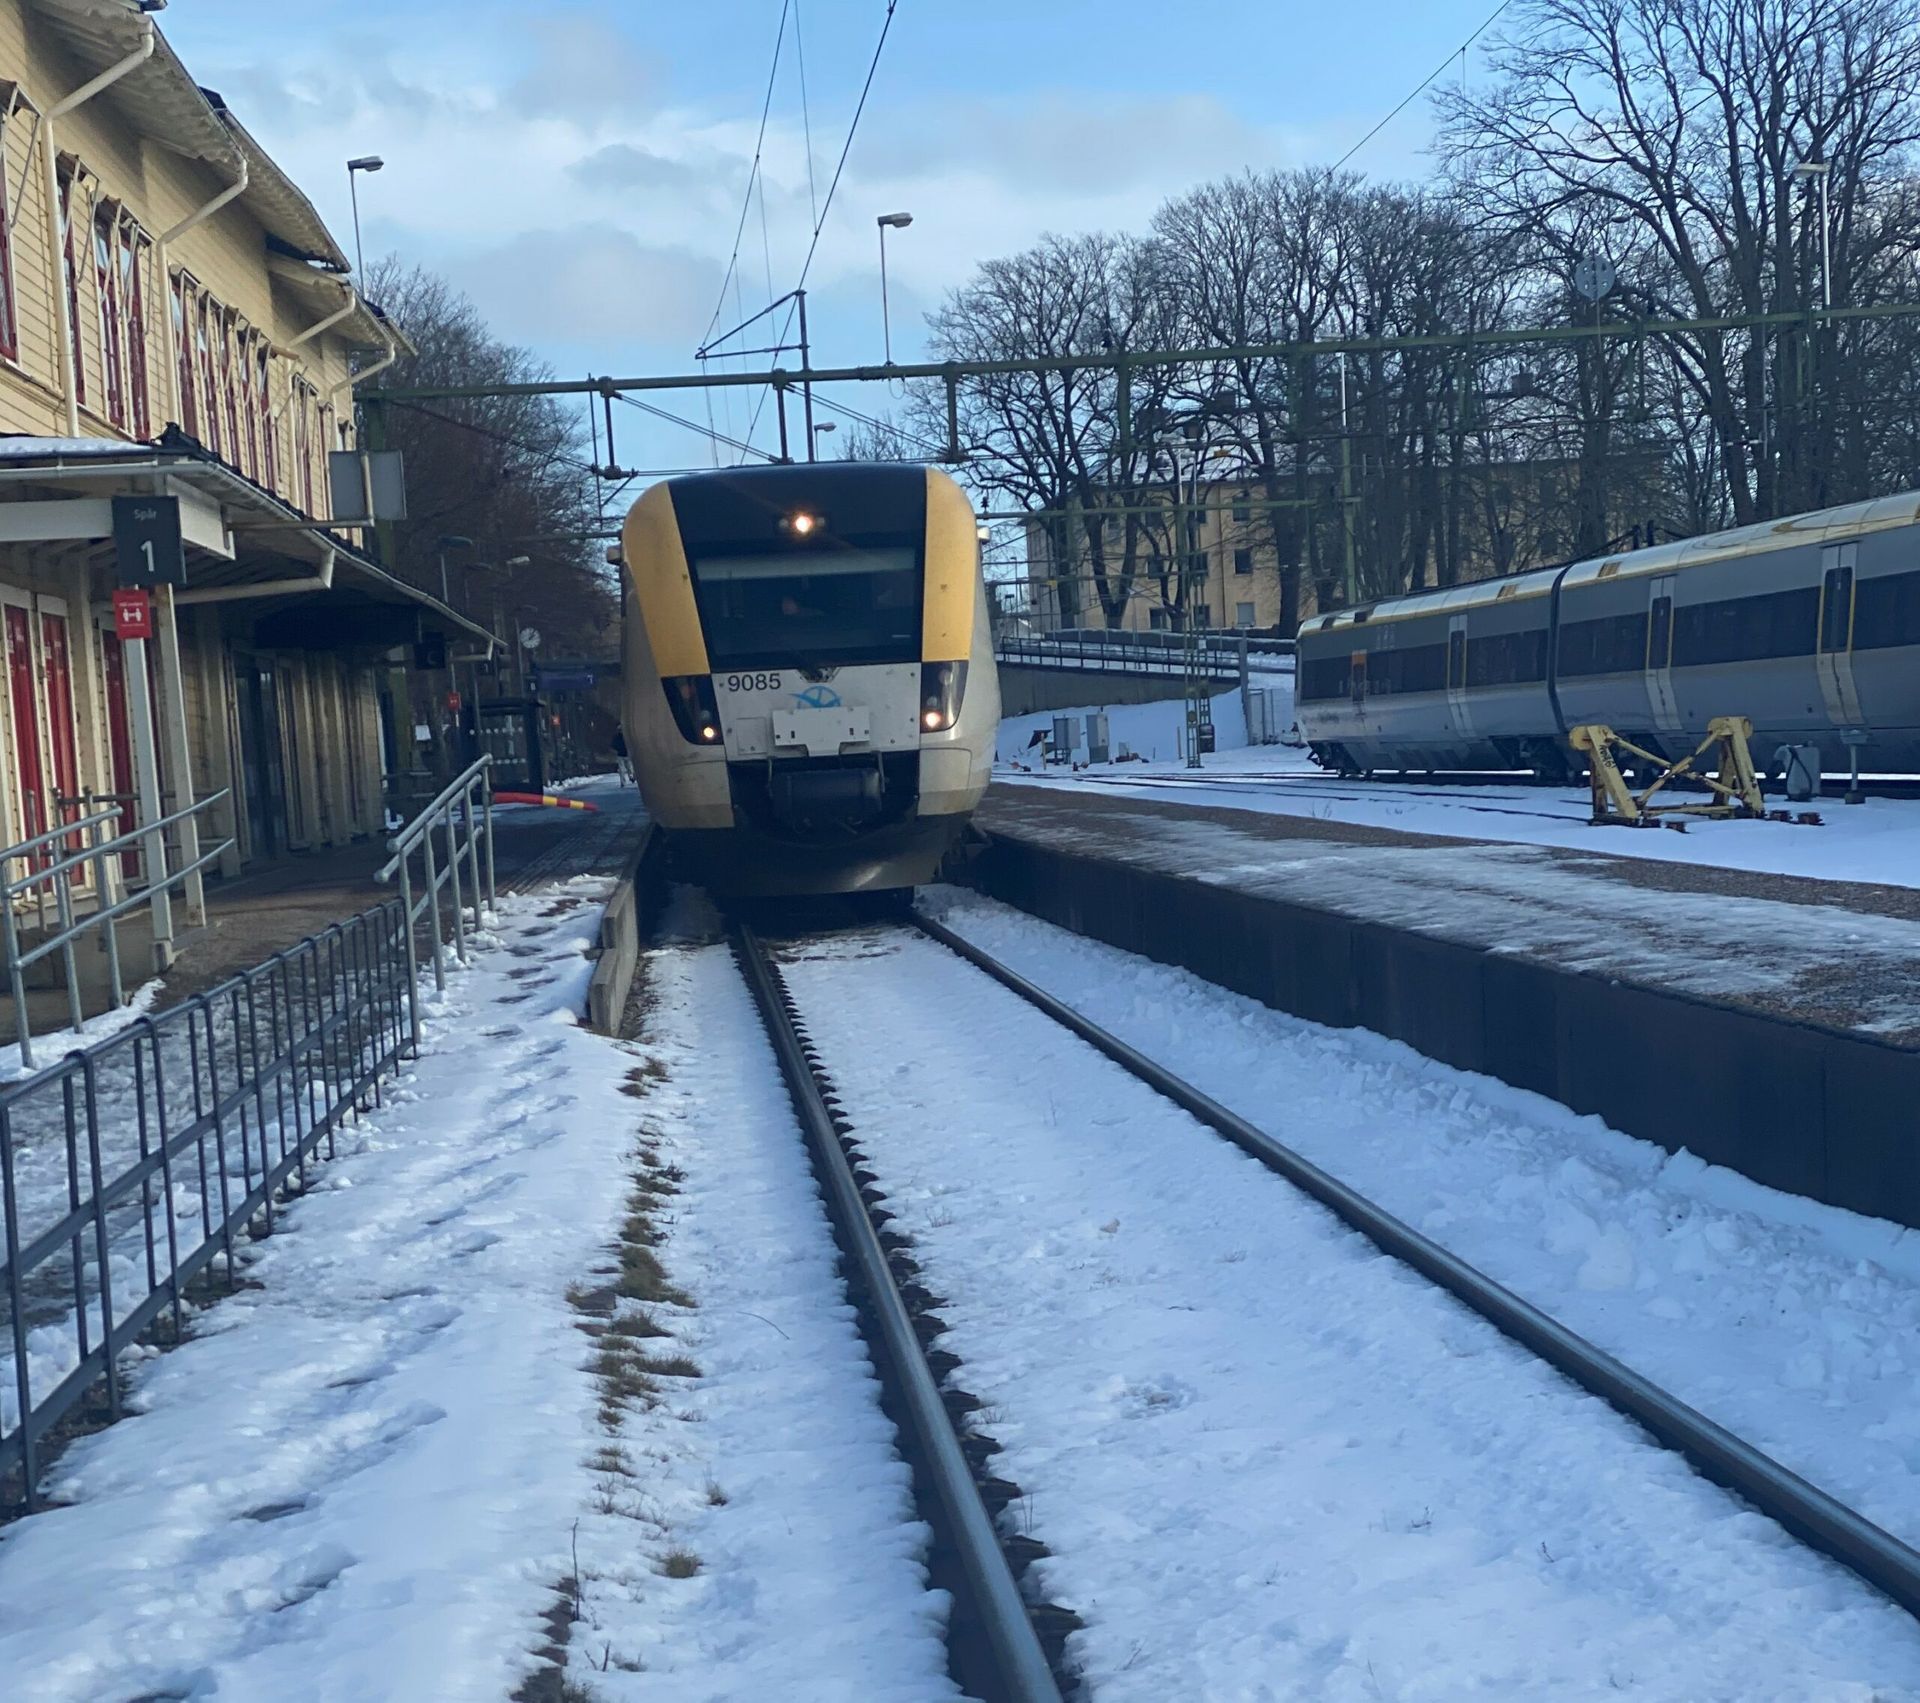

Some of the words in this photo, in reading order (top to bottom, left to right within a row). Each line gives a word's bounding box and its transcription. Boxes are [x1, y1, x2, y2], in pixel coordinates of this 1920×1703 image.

[134, 508, 157, 520] Spår
[140, 540, 154, 572] 1
[728, 673, 781, 692] 9085
